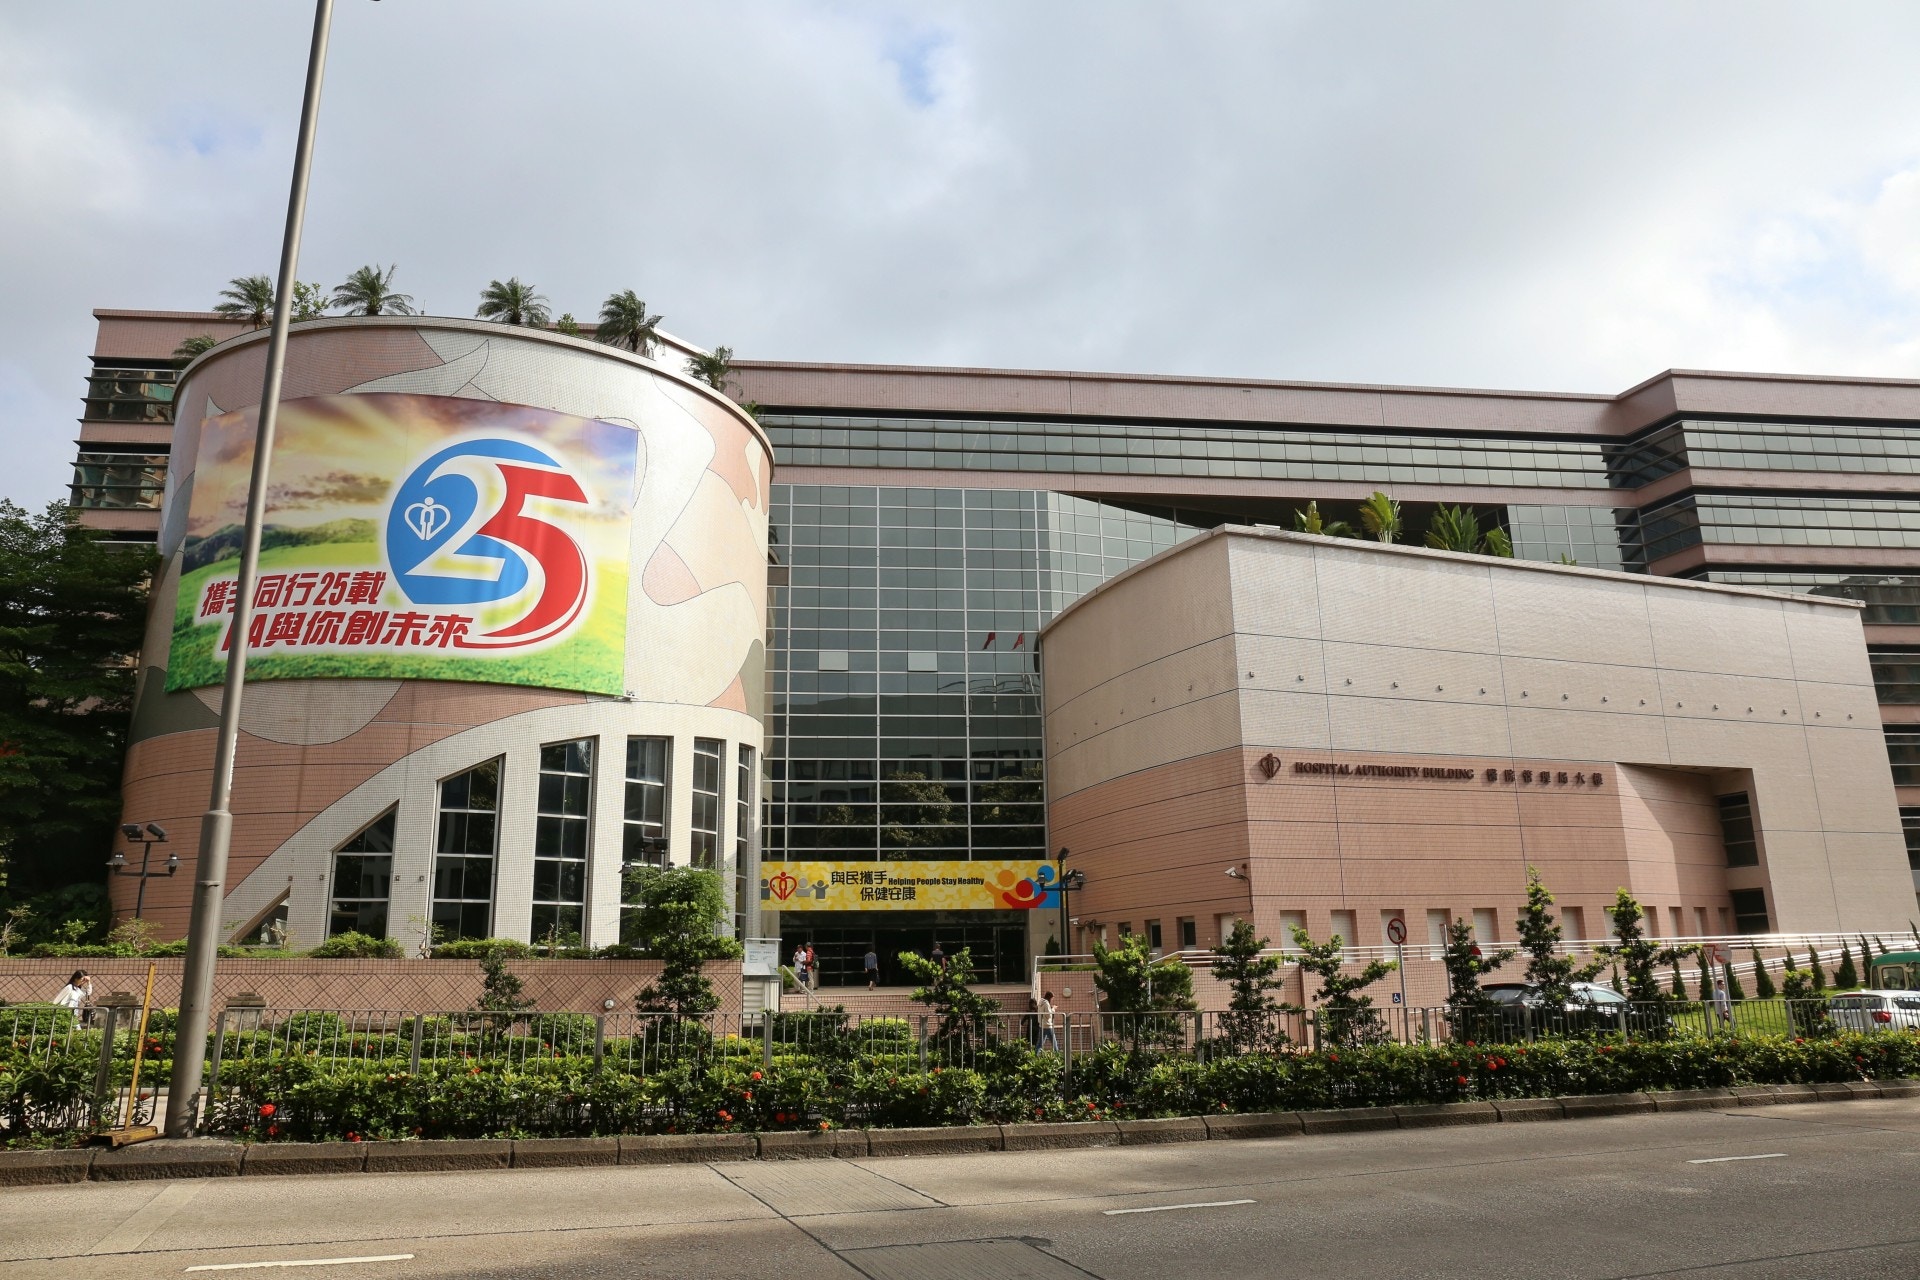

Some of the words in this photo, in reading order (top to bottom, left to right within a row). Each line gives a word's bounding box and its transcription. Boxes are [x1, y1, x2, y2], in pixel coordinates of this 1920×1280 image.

[404, 455, 589, 638] 25
[221, 611, 474, 652] A與你創未來
[1295, 761, 1353, 776] HOSPITAL
[1355, 764, 1420, 778] AUTHORITY
[1423, 767, 1475, 780] BUILDING
[831, 870, 888, 885] 與民攜手
[888, 877, 916, 886] Helping
[917, 877, 941, 886] People
[941, 877, 957, 886] Stay
[958, 877, 985, 886] Healthy
[860, 886, 917, 901] 保健安康
